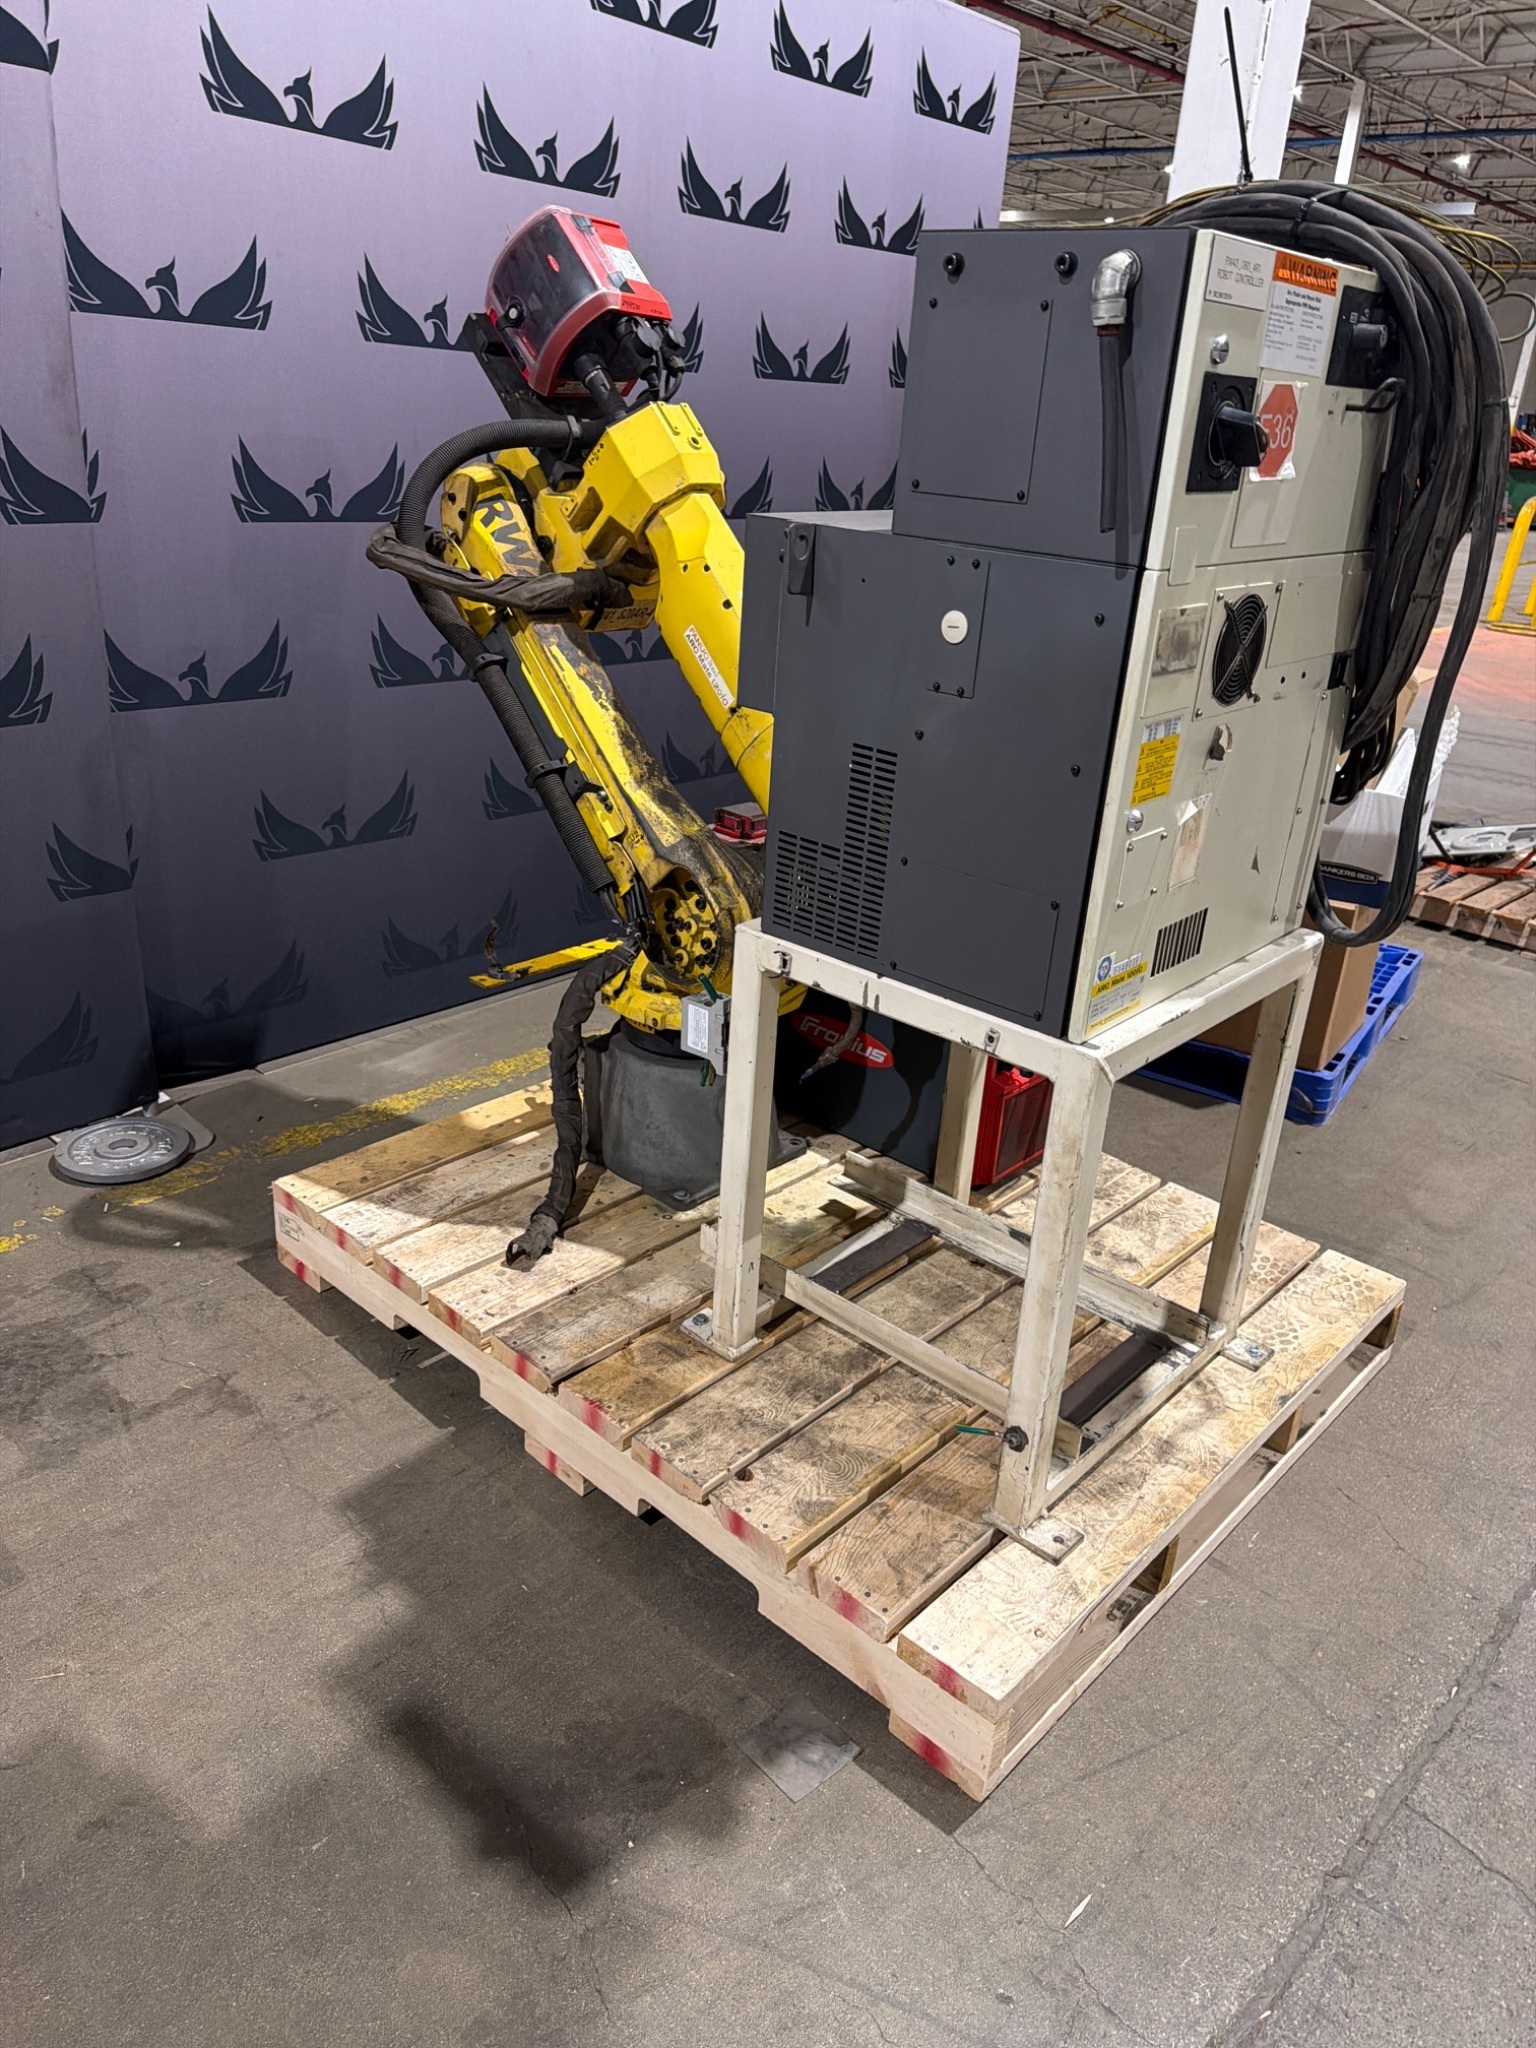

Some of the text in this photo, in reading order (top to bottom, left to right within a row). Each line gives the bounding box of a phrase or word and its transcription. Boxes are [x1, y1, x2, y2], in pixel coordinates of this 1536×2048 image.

[686, 634, 699, 654] ARC
[698, 654, 712, 678] Mate
[689, 627, 709, 660] FANUC
[1357, 872, 1376, 881] BOX
[1097, 982, 1110, 994] ARC
[800, 1016, 888, 1063] Froius
